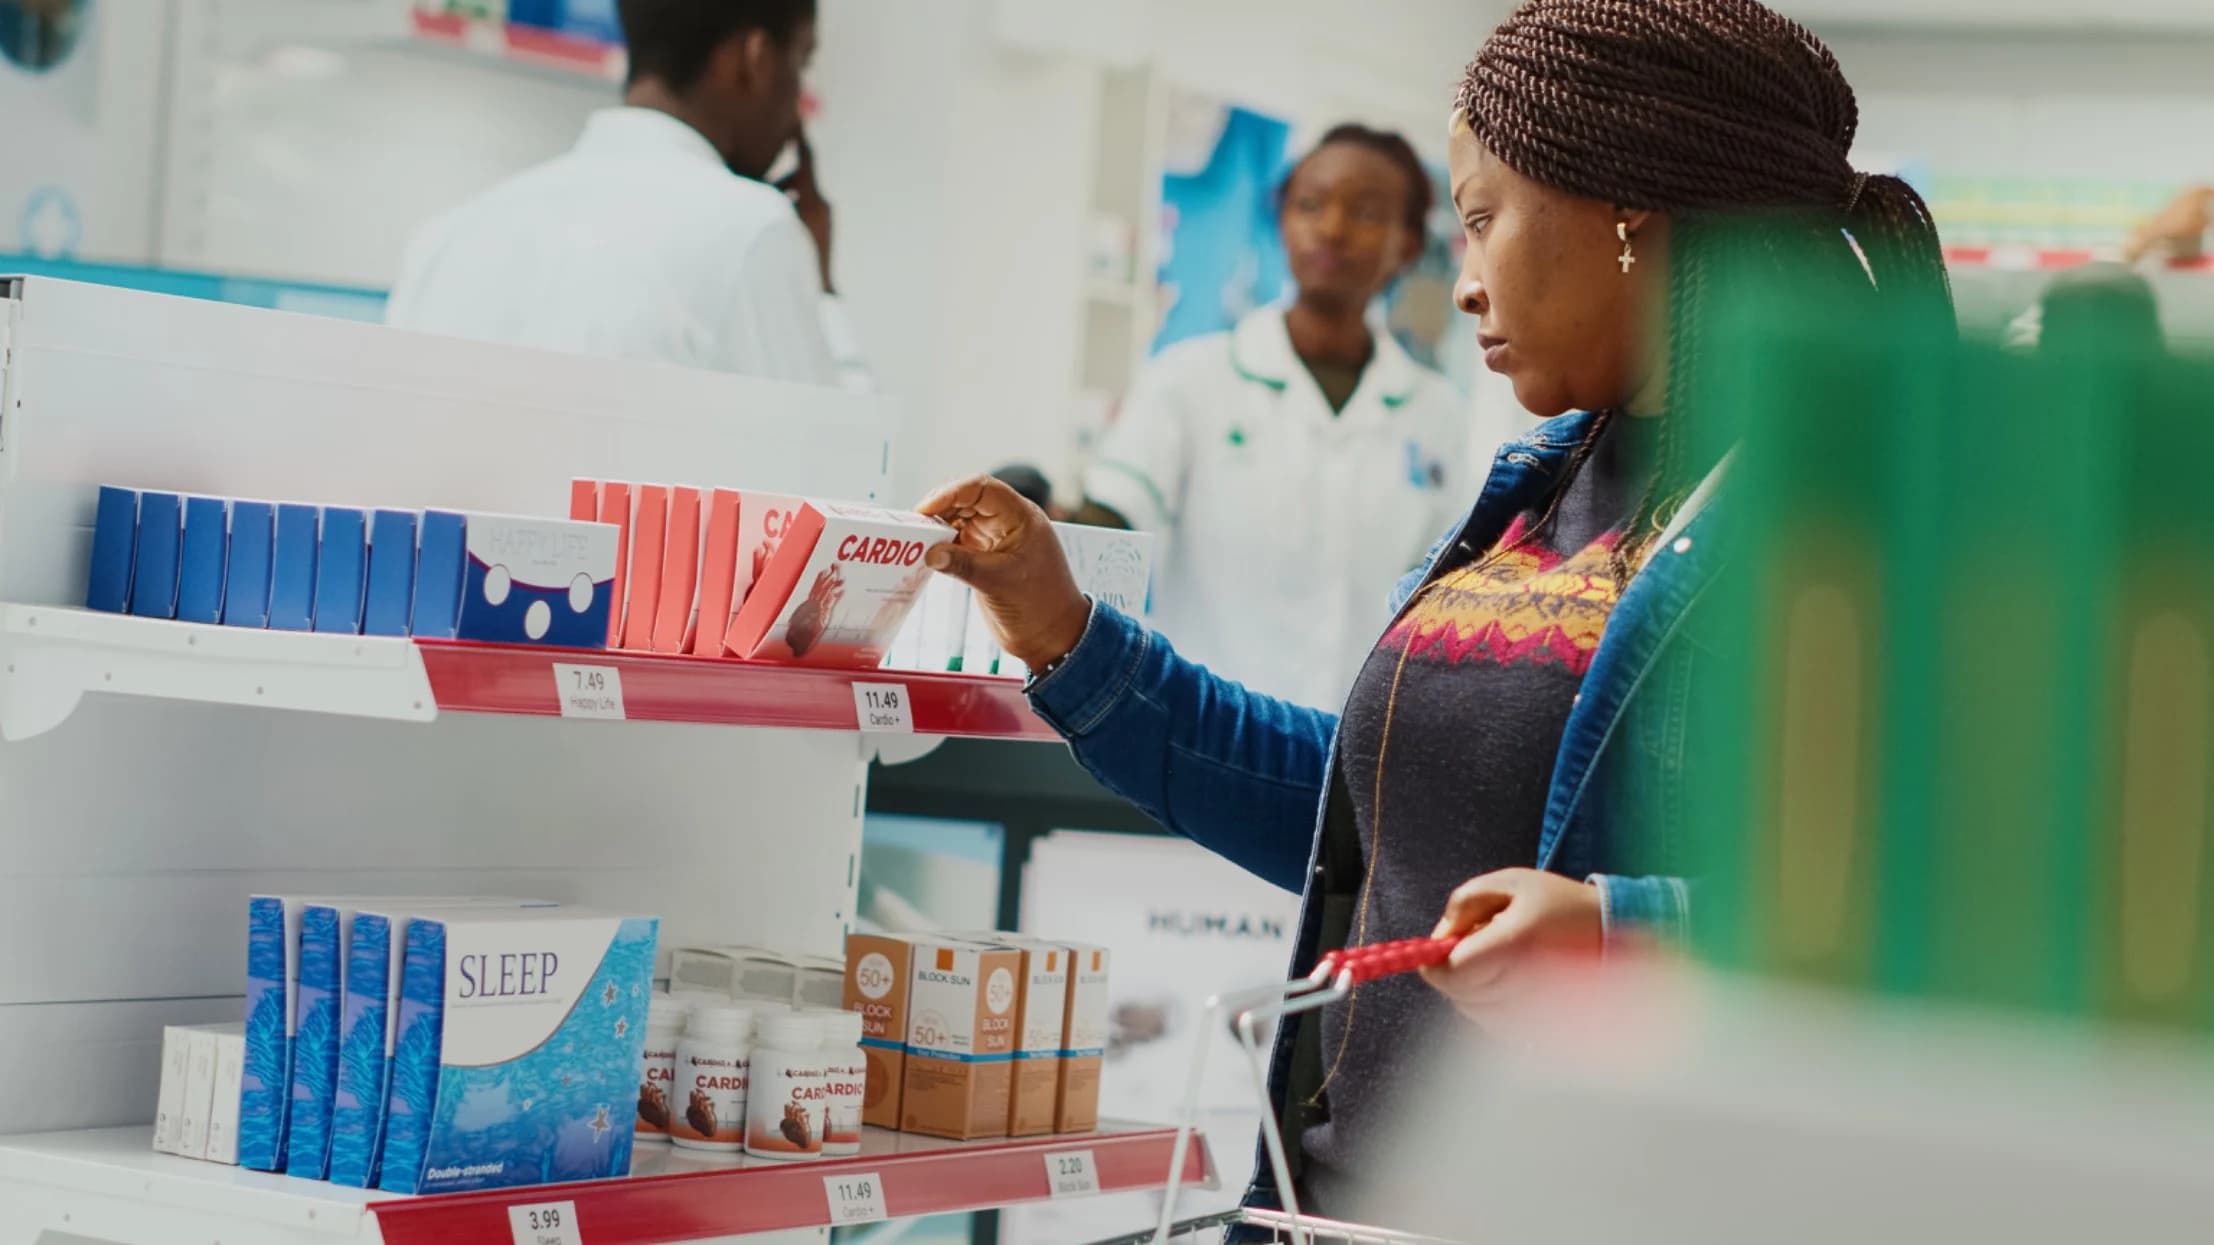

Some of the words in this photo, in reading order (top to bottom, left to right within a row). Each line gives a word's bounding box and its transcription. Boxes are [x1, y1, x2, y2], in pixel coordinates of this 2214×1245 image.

[488, 528, 547, 555] HAPPY
[551, 532, 589, 560] LIFE
[837, 534, 925, 567] CARDIO
[572, 670, 605, 691] 7.49
[570, 695, 597, 712] Happy
[599, 696, 616, 711] Life
[865, 690, 898, 709] 11.49
[870, 712, 894, 726] Cardio
[1148, 910, 1283, 939] HUMAN
[459, 951, 559, 999] SLEEP
[859, 967, 890, 988] 50+
[918, 970, 949, 984] BLOCK
[950, 974, 971, 986] SUN
[854, 1002, 893, 1018] BLOCK
[915, 1025, 946, 1046] 50+
[695, 1075, 748, 1091] CARDI
[824, 1082, 864, 1096] ARDIO
[791, 1086, 825, 1101] CAR
[427, 1161, 504, 1181] Double-stranded
[1058, 1157, 1082, 1175] 2.20
[837, 1181, 872, 1201] 11.49
[529, 1208, 560, 1230] 3.99
